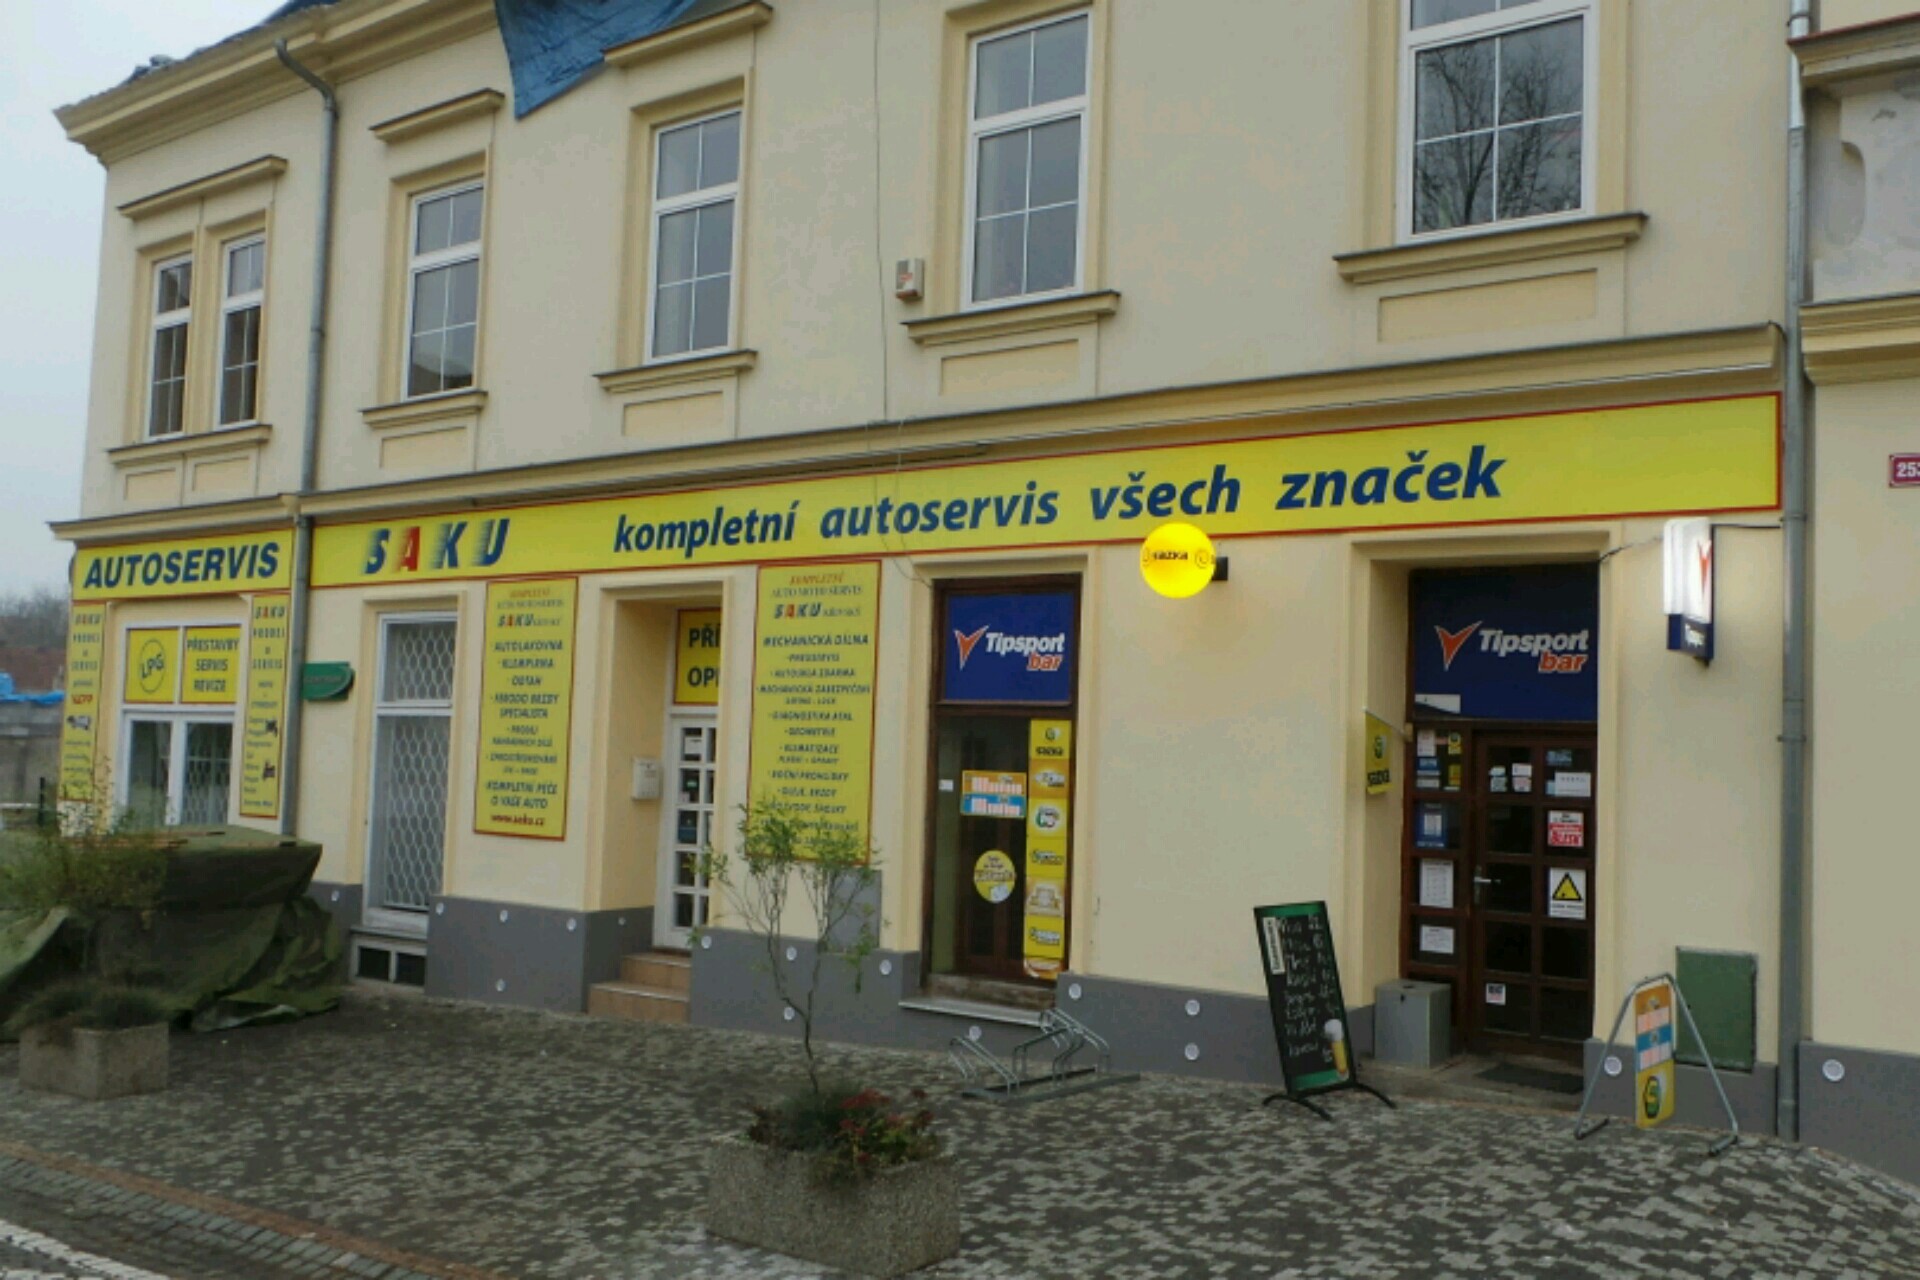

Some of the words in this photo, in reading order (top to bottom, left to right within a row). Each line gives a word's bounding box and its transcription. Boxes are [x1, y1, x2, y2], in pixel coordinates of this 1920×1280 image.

[614, 500, 798, 558] kompletní
[820, 481, 1059, 539] autoservis
[1090, 464, 1240, 520] všech
[1275, 445, 1506, 511] značek
[362, 518, 510, 574] SAKU
[83, 542, 279, 589] AUTOSERVIS
[498, 613, 534, 628] SAKU
[774, 603, 822, 619] SAKU
[985, 631, 1065, 657] Tipsport
[1479, 629, 1589, 657] Tipsport
[1026, 652, 1064, 672] bar
[1538, 651, 1589, 673] bar
